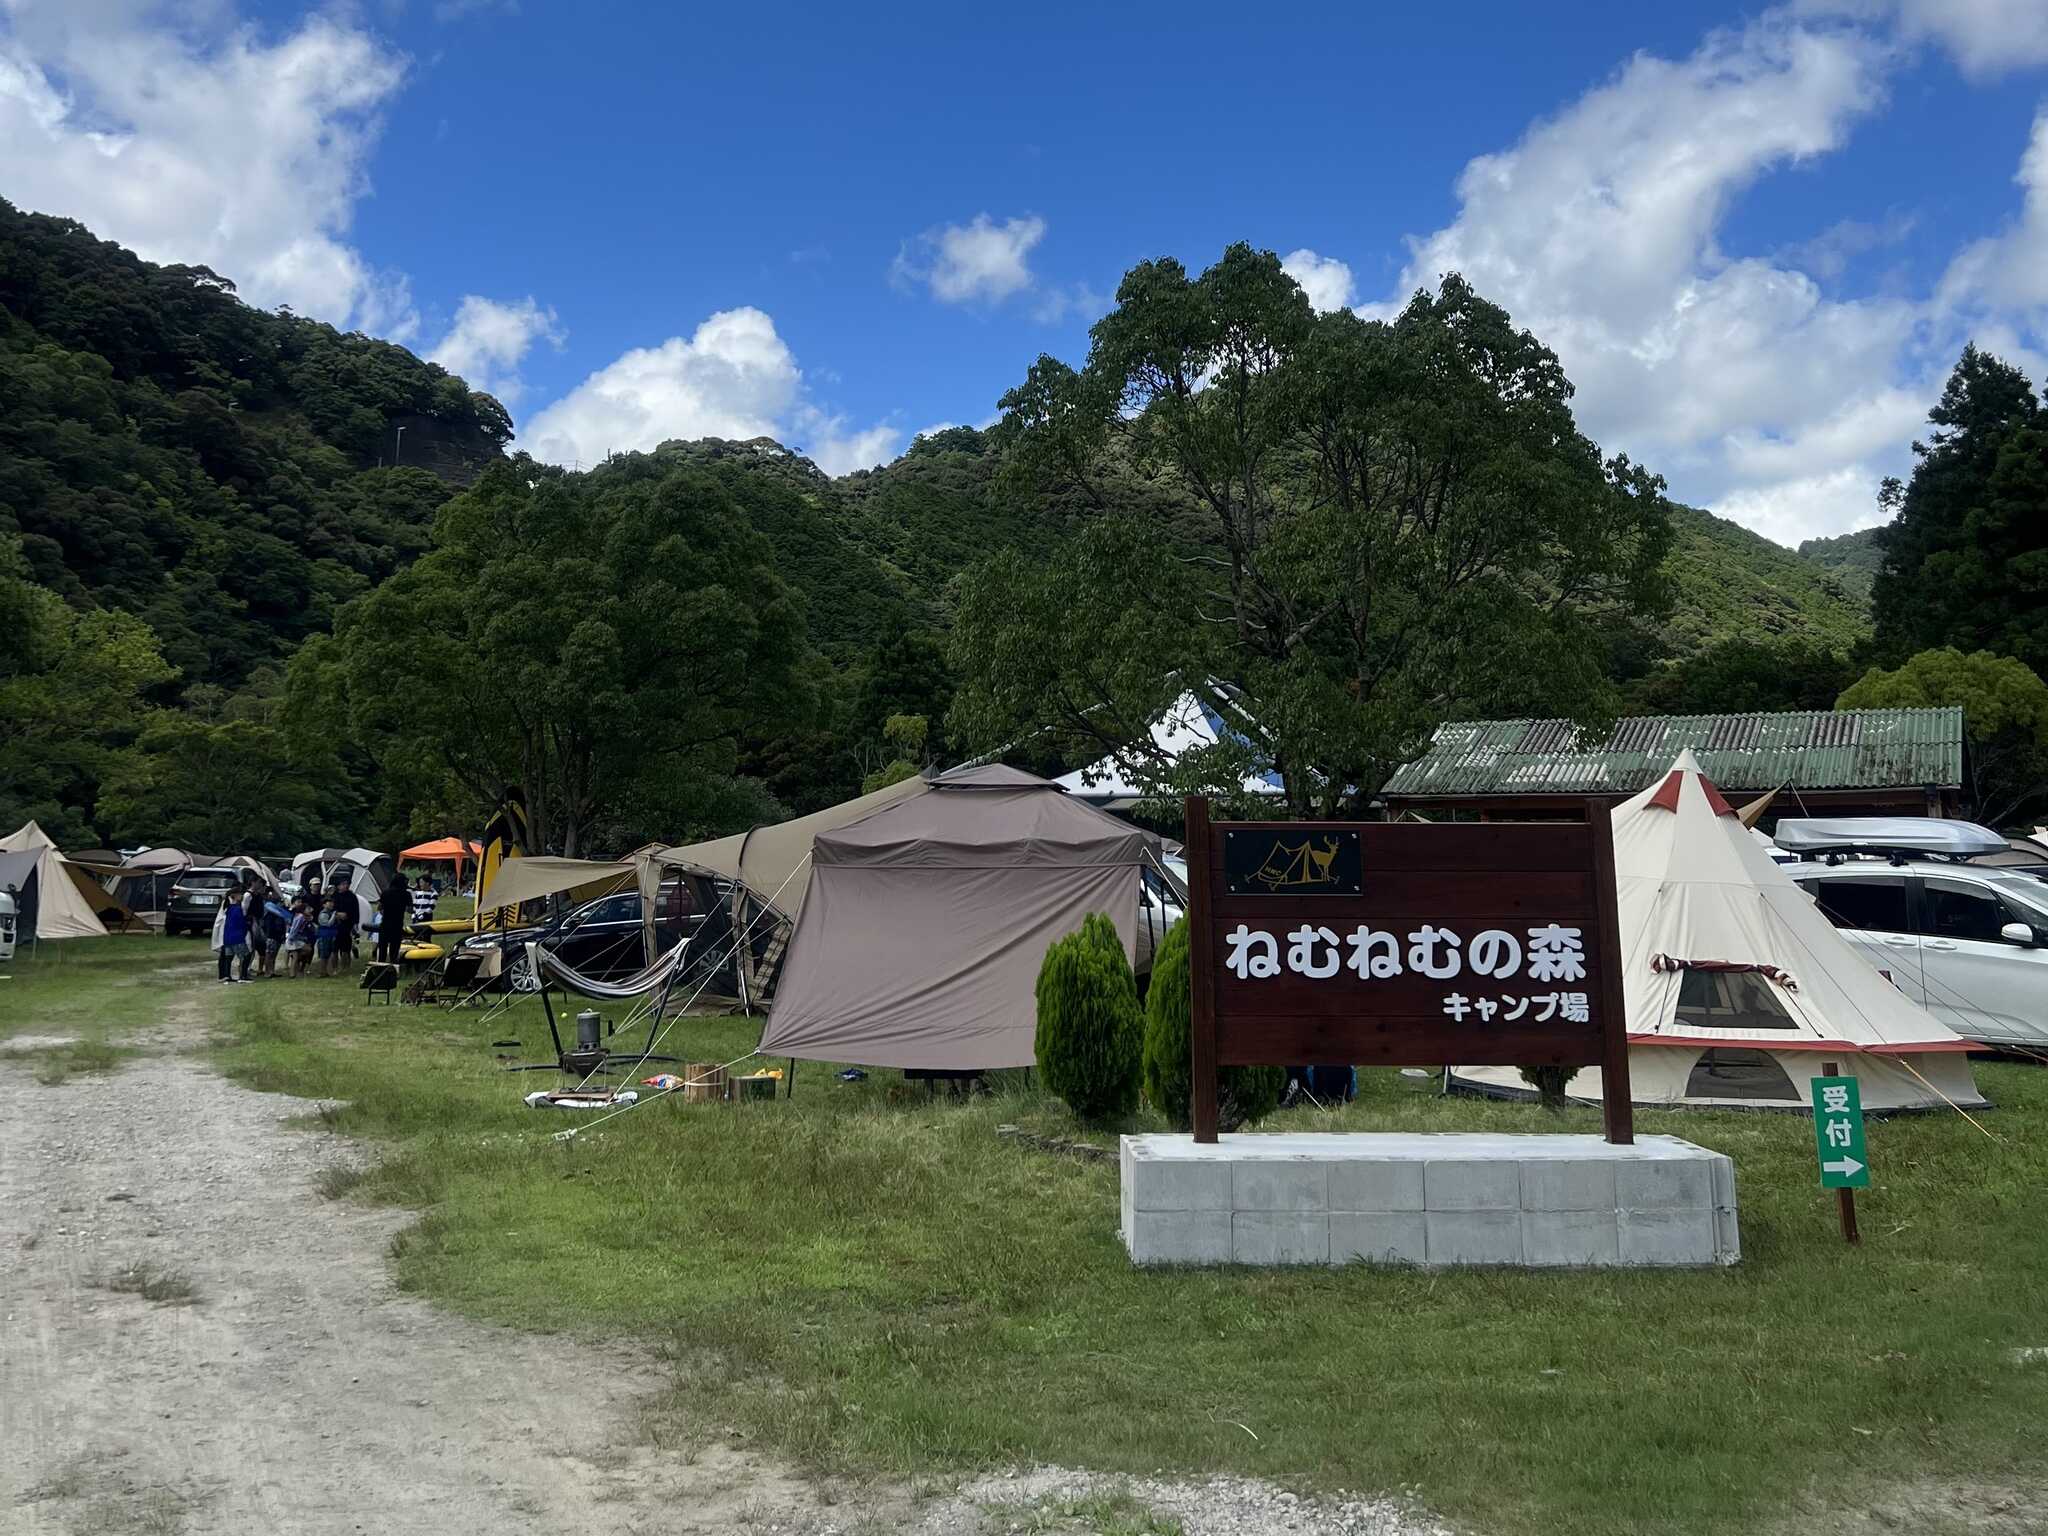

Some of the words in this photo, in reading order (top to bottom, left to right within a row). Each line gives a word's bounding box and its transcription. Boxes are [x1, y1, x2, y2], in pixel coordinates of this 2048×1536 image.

[1225, 923, 1586, 982] ねむねむの森
[1443, 992, 1589, 1022] キャンプ場
[1822, 1085, 1852, 1147] 受付
